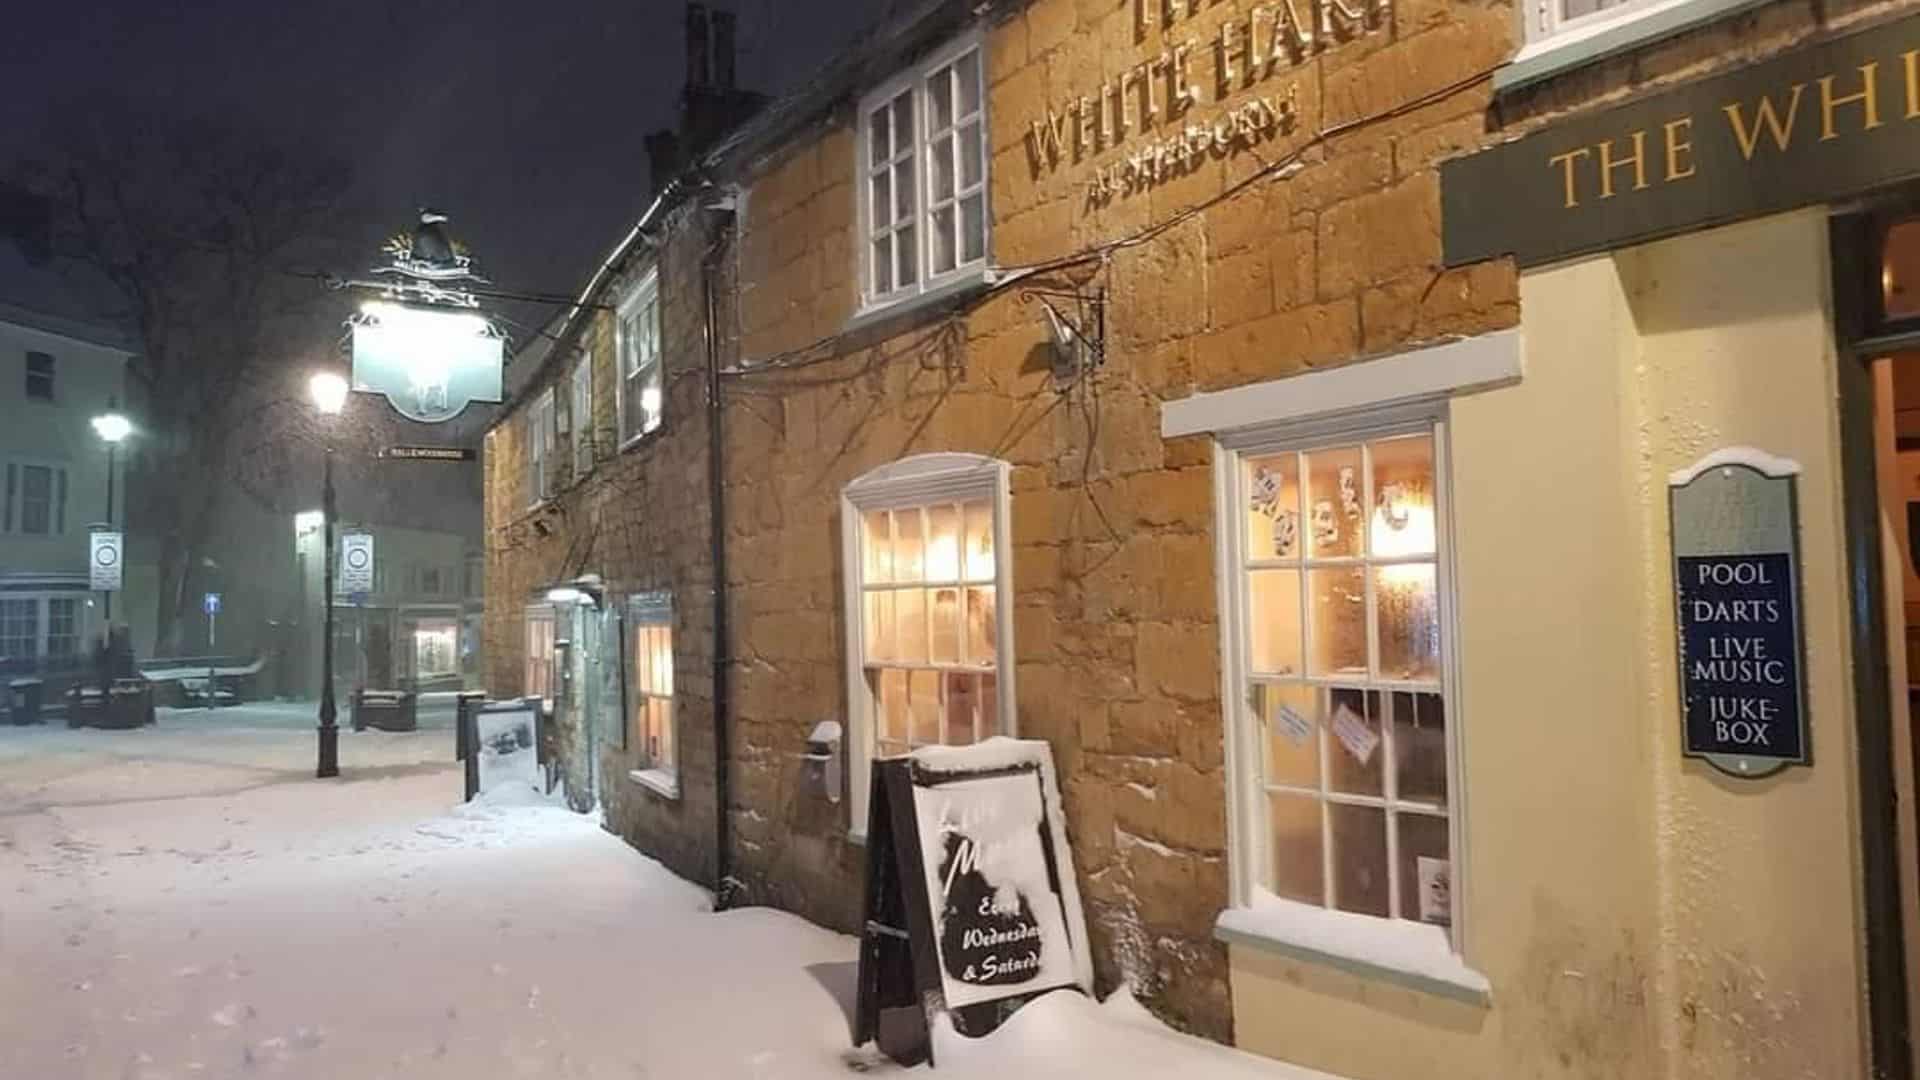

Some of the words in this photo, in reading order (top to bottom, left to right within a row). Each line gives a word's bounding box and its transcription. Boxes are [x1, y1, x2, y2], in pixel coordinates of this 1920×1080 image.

[1026, 38, 1198, 174] WHITE
[1218, 0, 1394, 92] HAR
[1549, 118, 1696, 208] THE
[1722, 50, 1920, 161] WHI
[1698, 563, 1772, 585] POOL
[1694, 600, 1779, 623] DARTS
[1709, 637, 1767, 660] LIVE
[1694, 660, 1785, 684] MUSIC
[1709, 696, 1779, 722] JUKE-
[1715, 721, 1769, 745] BOX
[962, 923, 1040, 950] Wednesda
[962, 965, 977, 981] &
[979, 952, 1039, 981] Saturd
